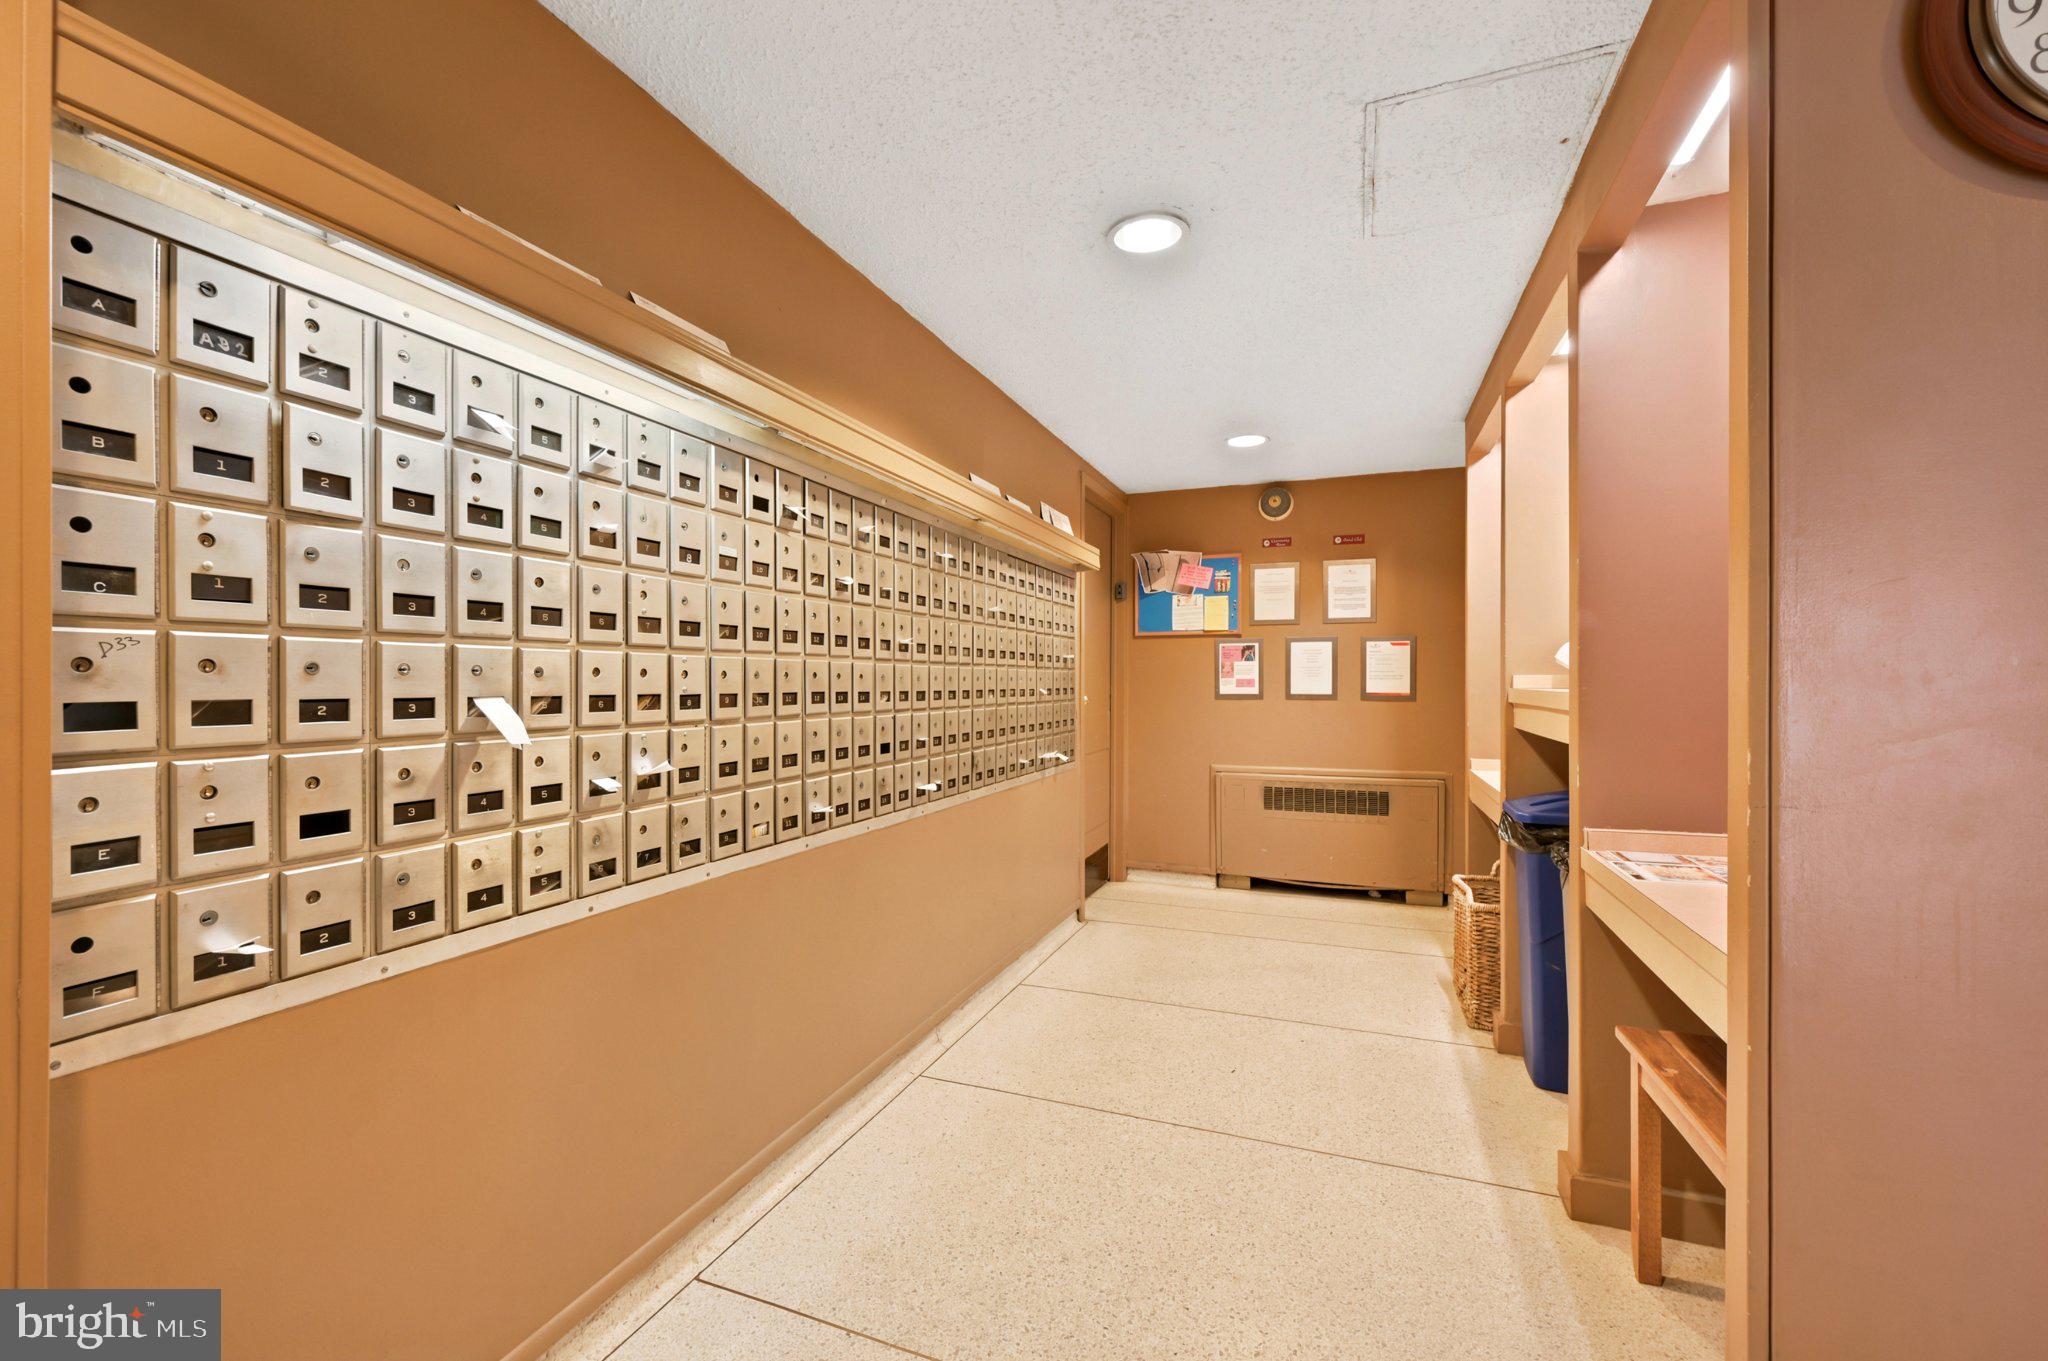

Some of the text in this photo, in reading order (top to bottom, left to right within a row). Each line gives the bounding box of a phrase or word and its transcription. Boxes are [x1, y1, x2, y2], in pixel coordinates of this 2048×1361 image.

[91, 298, 106, 312] A
[318, 367, 328, 379] 2
[408, 394, 417, 404] 3
[91, 436, 105, 448] B
[541, 435, 549, 445] 5
[215, 459, 227, 471] 1
[320, 477, 330, 488] 2
[407, 498, 416, 507] 3
[480, 513, 488, 521] 4
[686, 553, 692, 563] 8
[93, 581, 107, 593] C
[214, 577, 225, 589] 1
[317, 593, 328, 604] 2
[408, 602, 417, 611] 3
[480, 608, 487, 616] 4
[542, 613, 549, 621] 5
[599, 618, 605, 626] 6
[317, 705, 327, 716] 2
[408, 703, 417, 713] 3
[541, 790, 548, 798] 5
[480, 798, 488, 806] 4
[407, 807, 416, 816] 3
[98, 848, 111, 861] E
[541, 877, 548, 885] 5
[480, 893, 488, 902] 4
[408, 911, 416, 920] 3
[319, 932, 329, 943] 2
[217, 957, 228, 968] 1
[92, 985, 105, 1000] F
